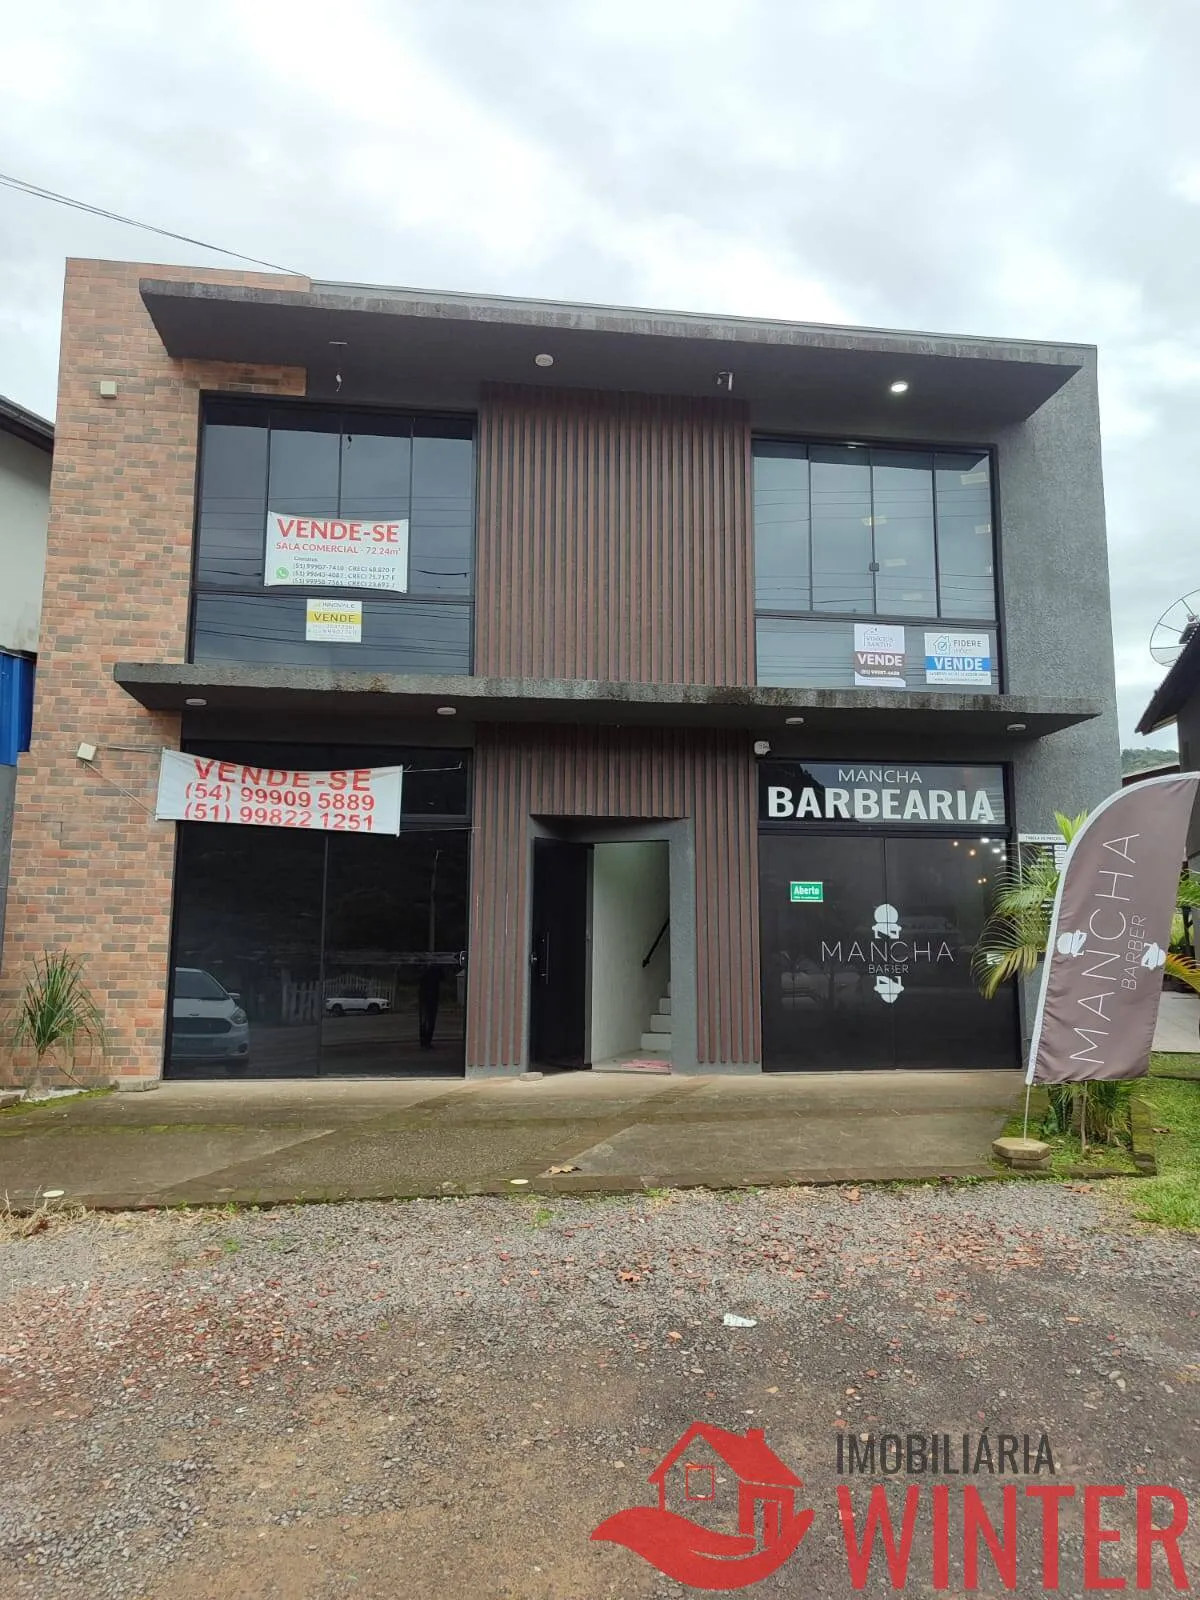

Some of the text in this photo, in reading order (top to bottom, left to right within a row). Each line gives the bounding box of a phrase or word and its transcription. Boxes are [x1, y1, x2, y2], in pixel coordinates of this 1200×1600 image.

[277, 518, 399, 543] VENDE-SE
[276, 542, 300, 551] SALA
[302, 543, 358, 554] COMERCIAL
[314, 613, 356, 622] VENDE
[953, 639, 983, 648] FIDERE
[857, 653, 903, 667] VENDE
[934, 656, 983, 671] VENDE
[193, 757, 372, 792] VENDE-SE
[838, 768, 923, 784] MANCHA
[185, 782, 375, 811] (54) 99909 5889
[767, 786, 996, 820] BARBEARIA
[185, 802, 374, 831] (51) 99822 1251
[794, 885, 820, 895] Aberto
[821, 941, 954, 963] MANCHA
[1069, 832, 1140, 1064] MANCHA
[1121, 914, 1147, 990] BARBER
[868, 964, 909, 974] BARBER
